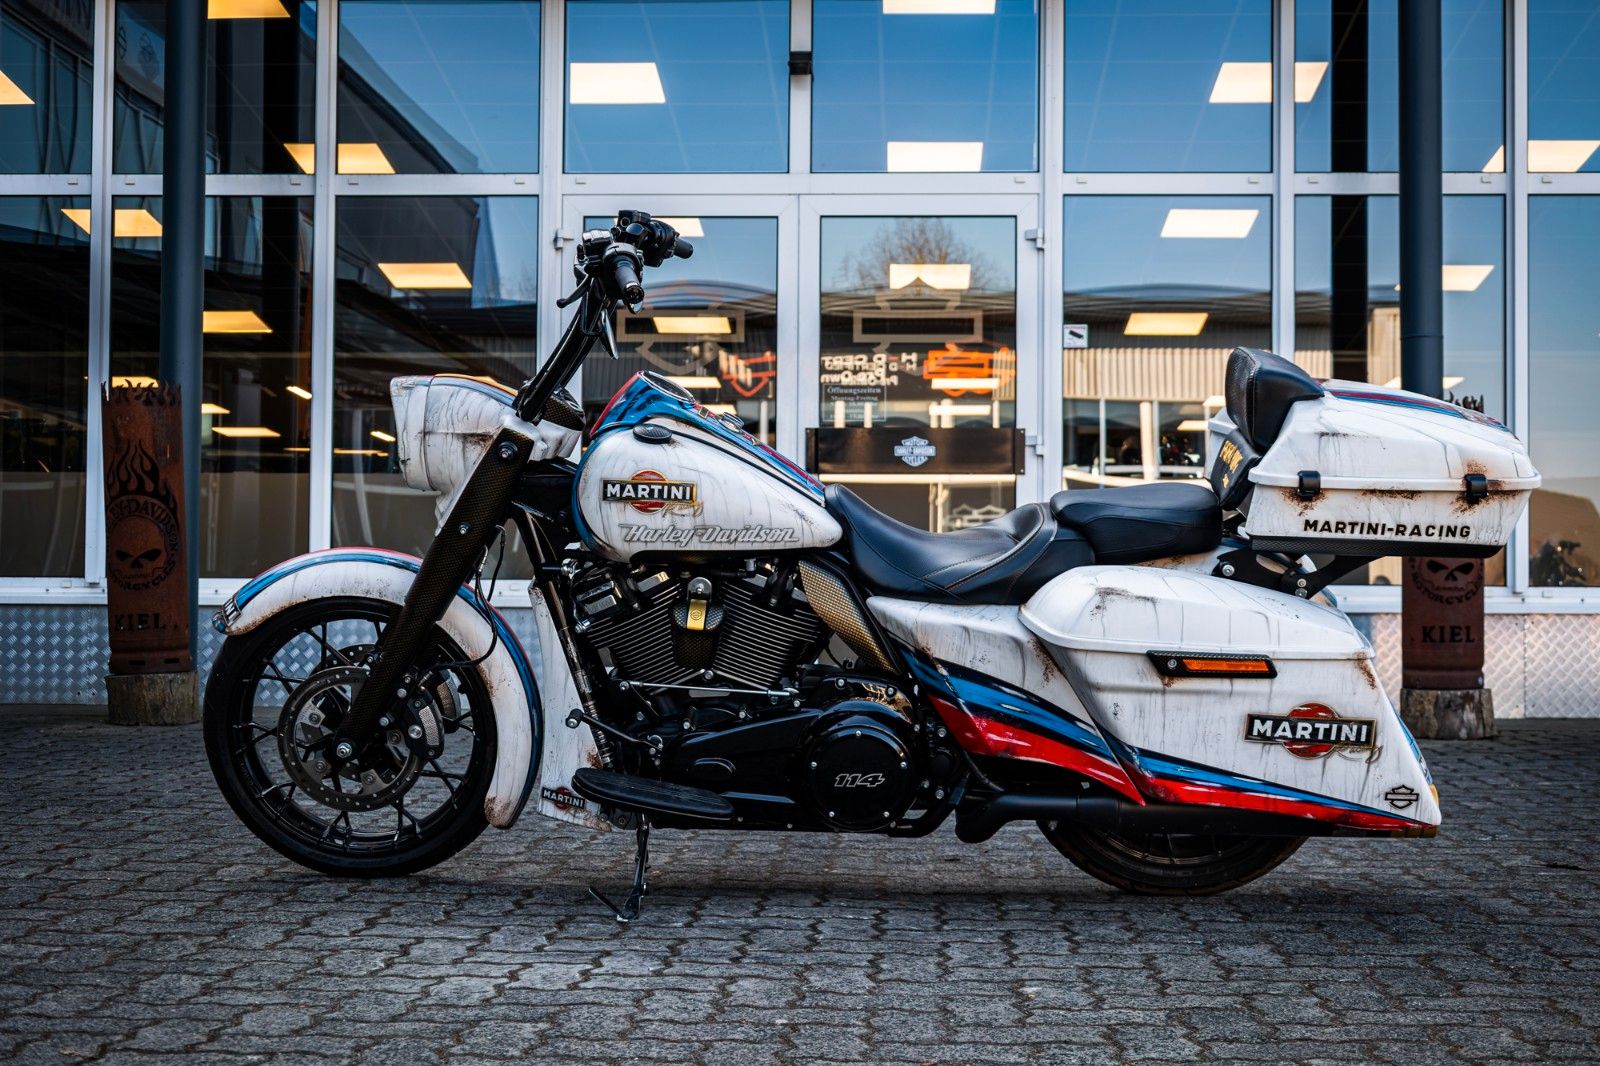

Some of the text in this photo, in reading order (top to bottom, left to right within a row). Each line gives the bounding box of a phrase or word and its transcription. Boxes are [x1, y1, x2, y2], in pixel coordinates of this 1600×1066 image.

[606, 483, 691, 500] MARTINI
[618, 523, 801, 548] Harley-Davidson
[1302, 518, 1471, 538] MARTINI-RACING
[113, 613, 166, 633] KIEL
[1421, 625, 1475, 643] KIEL
[1252, 719, 1368, 742] MARTINI
[833, 772, 886, 787] 114
[543, 788, 584, 808] MARTINI
